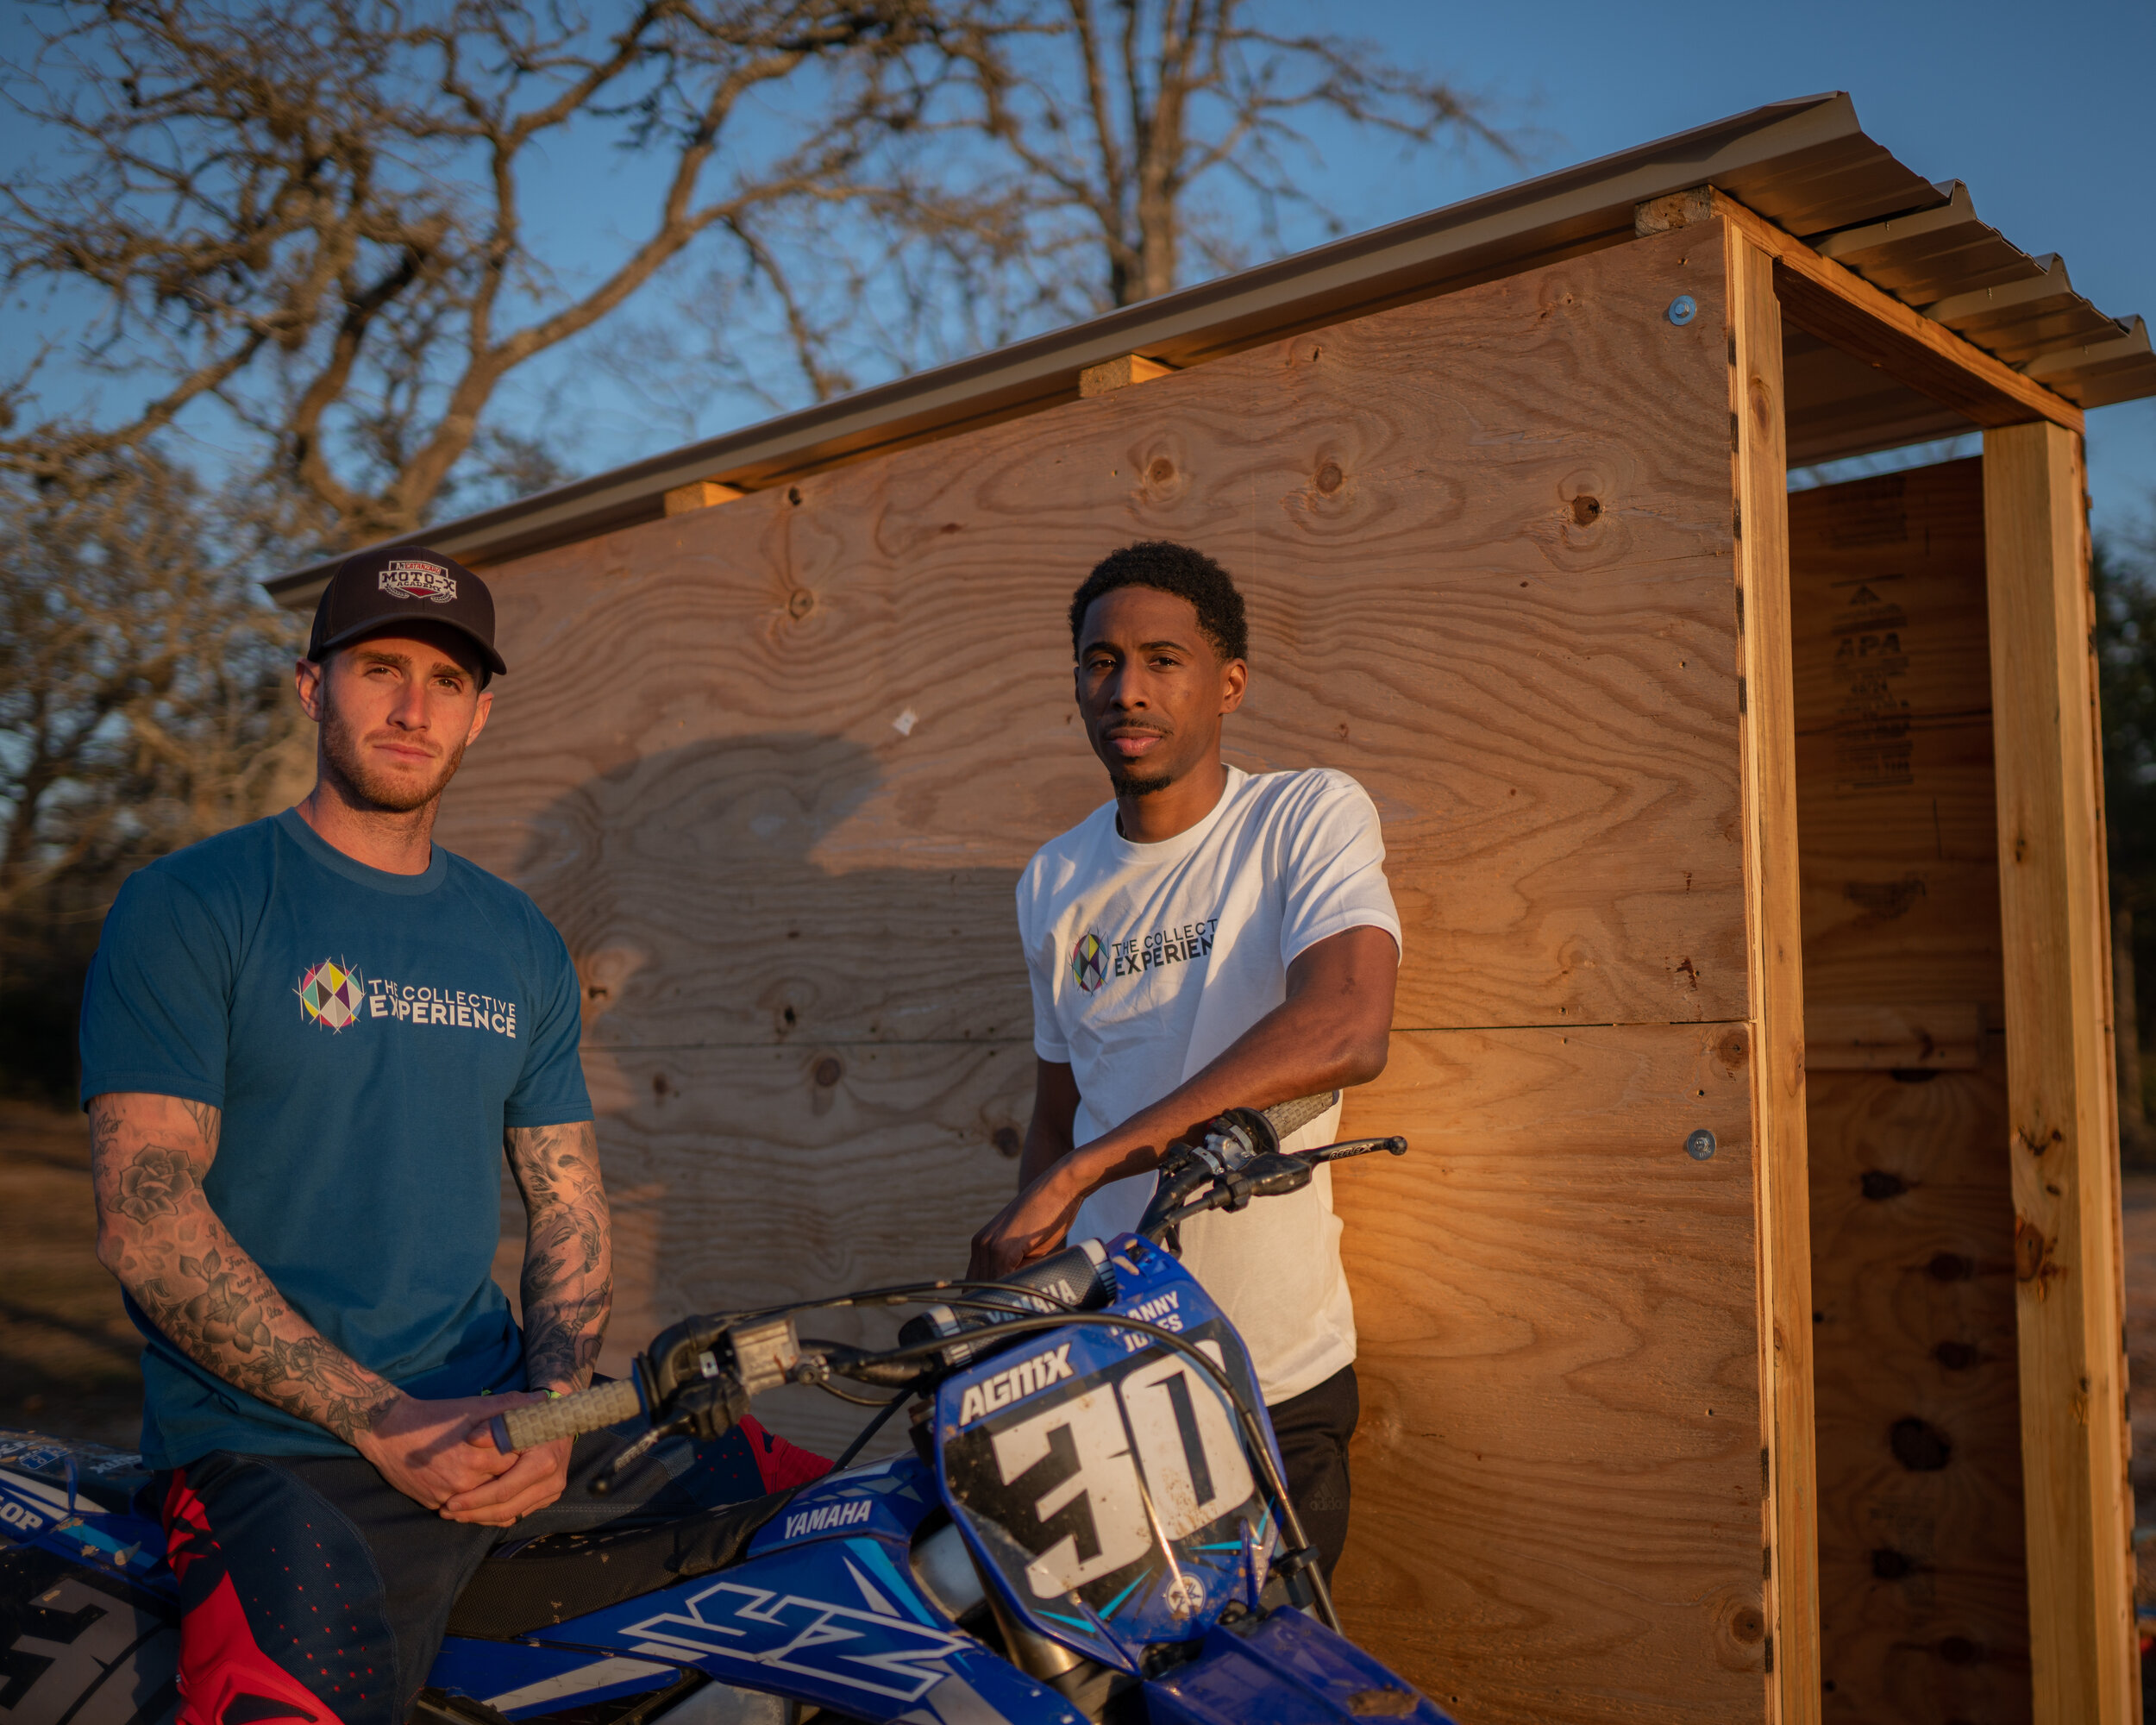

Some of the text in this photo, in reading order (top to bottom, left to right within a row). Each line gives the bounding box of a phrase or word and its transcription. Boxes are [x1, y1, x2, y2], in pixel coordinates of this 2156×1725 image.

[381, 571, 455, 593] MOTO-X
[404, 562, 441, 574] CATANZARO
[396, 580, 442, 592] ACADEMY
[1112, 918, 1218, 957] THE COLLECT
[368, 979, 516, 1018] THE COLLECTIVE
[370, 994, 517, 1038] EXPERIENCE
[1329, 1143, 1375, 1161] REFLEX
[254, 1284, 277, 1304] with
[991, 1338, 1256, 1600] 30
[784, 1499, 873, 1540] YAMAHA
